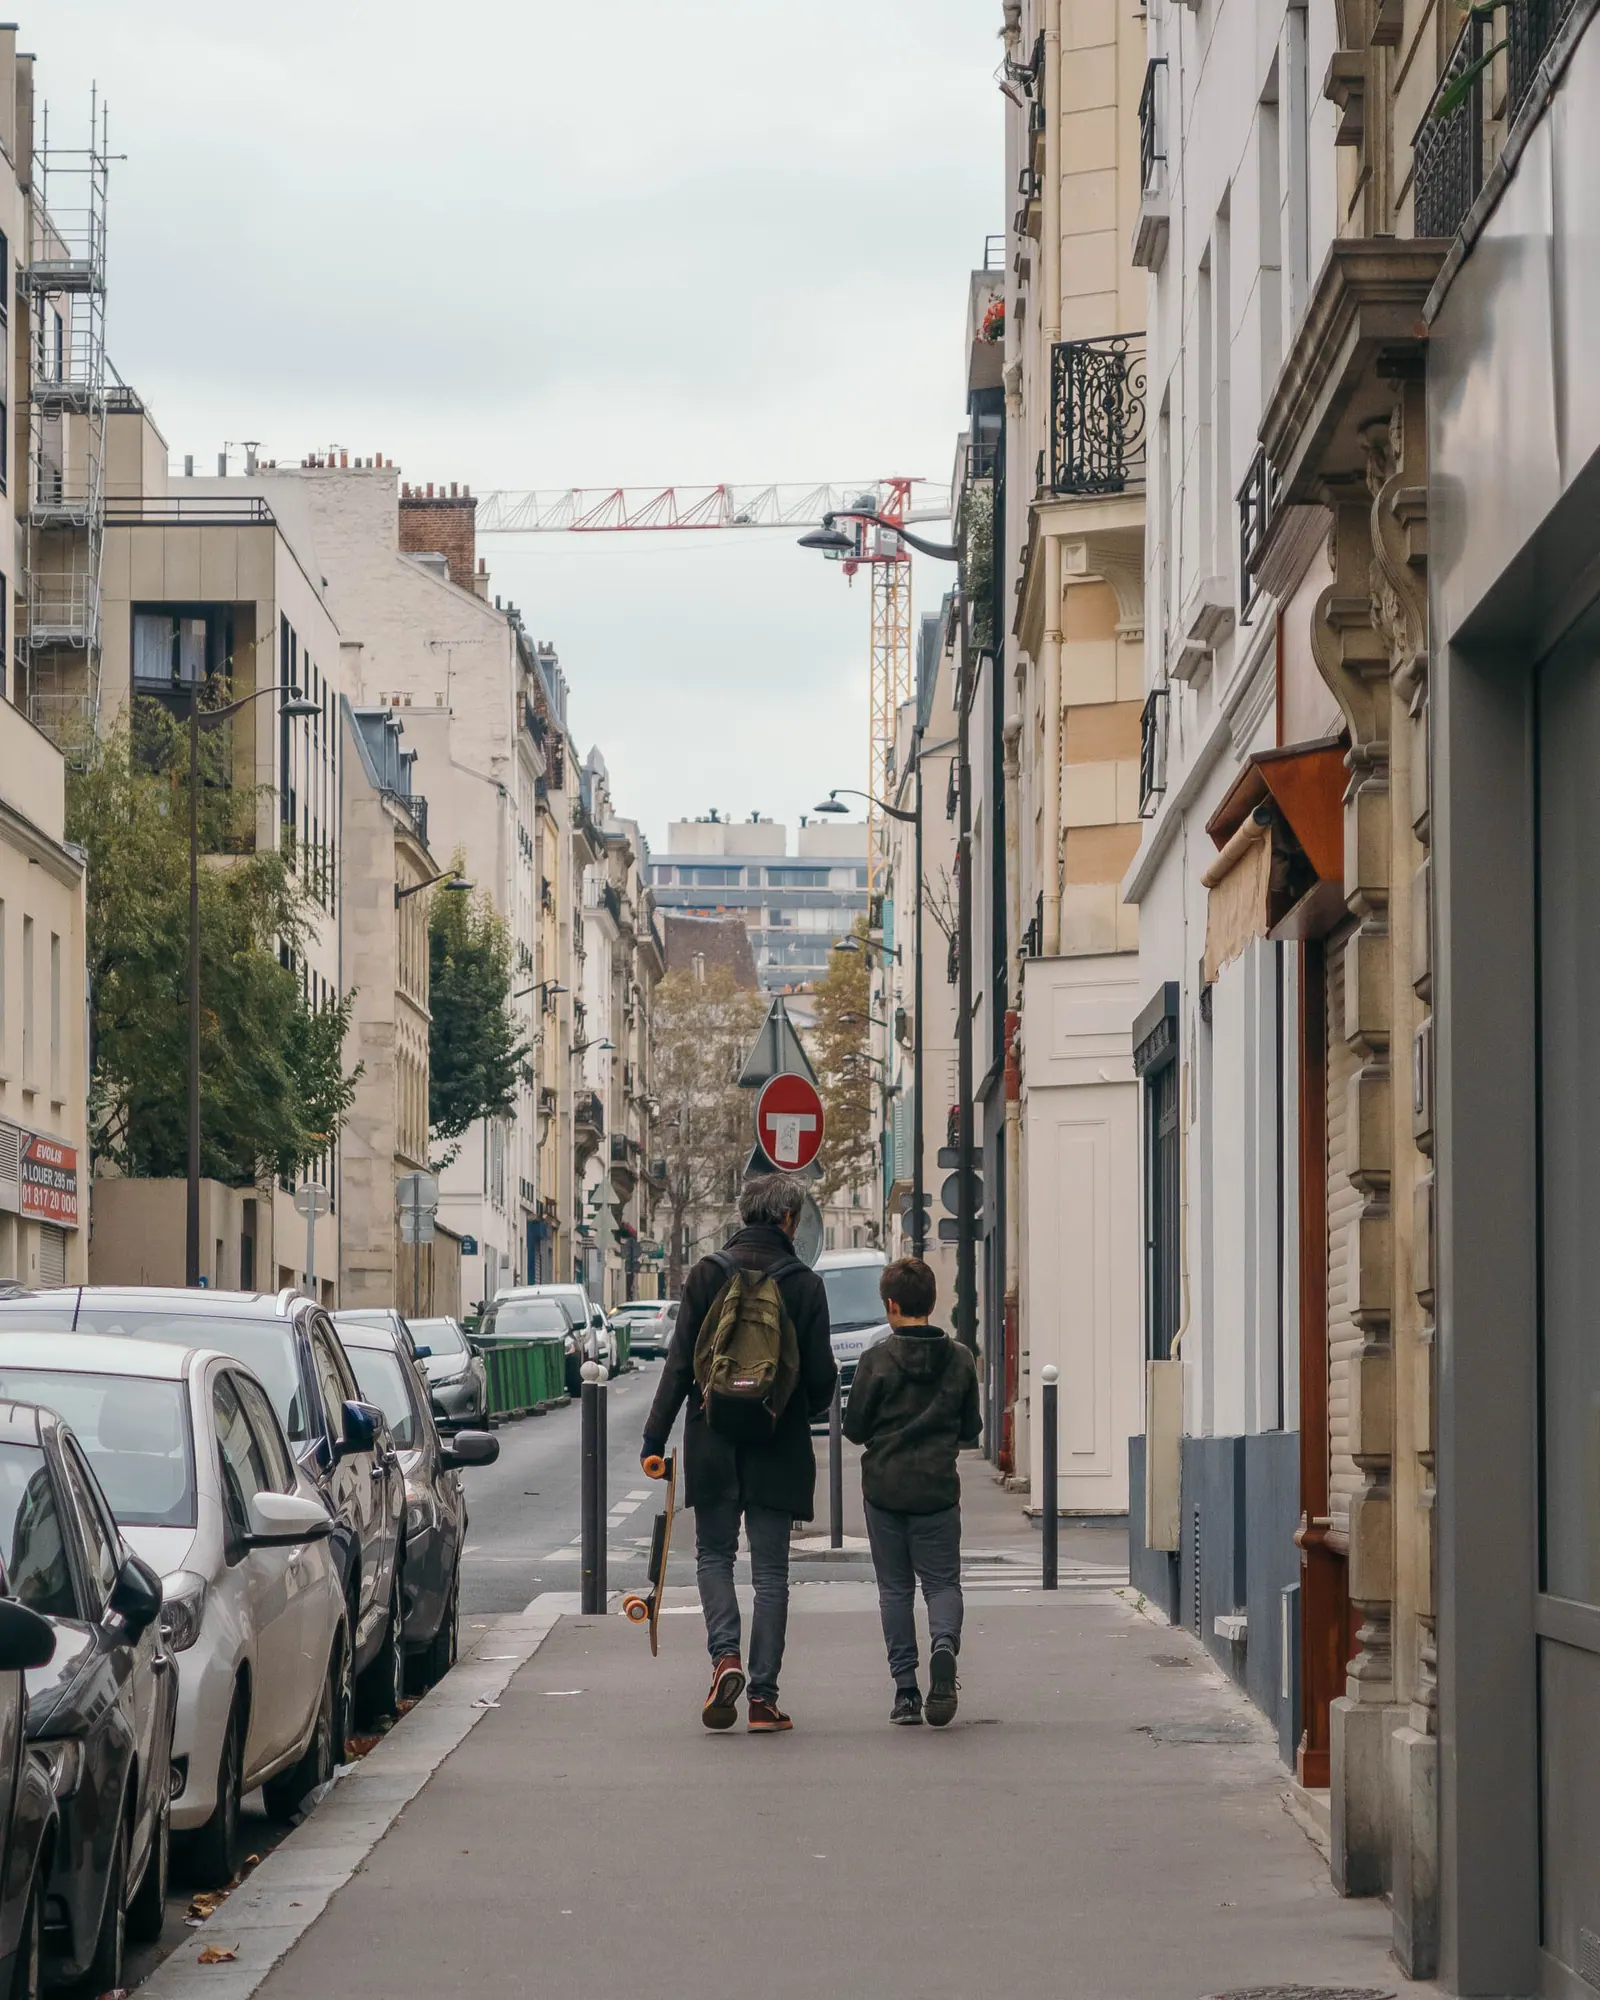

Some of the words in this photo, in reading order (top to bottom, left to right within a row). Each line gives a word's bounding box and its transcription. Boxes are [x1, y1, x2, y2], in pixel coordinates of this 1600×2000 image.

[36, 1144, 62, 1163] EVOLIS
[22, 1163, 28, 1180] A
[29, 1164, 53, 1186] LOUER
[54, 1171, 65, 1189] 295
[22, 1184, 31, 1204] 01
[34, 1187, 48, 1207] 817
[50, 1190, 59, 1211] 20
[61, 1194, 76, 1213] 000
[833, 1341, 863, 1350] ation
